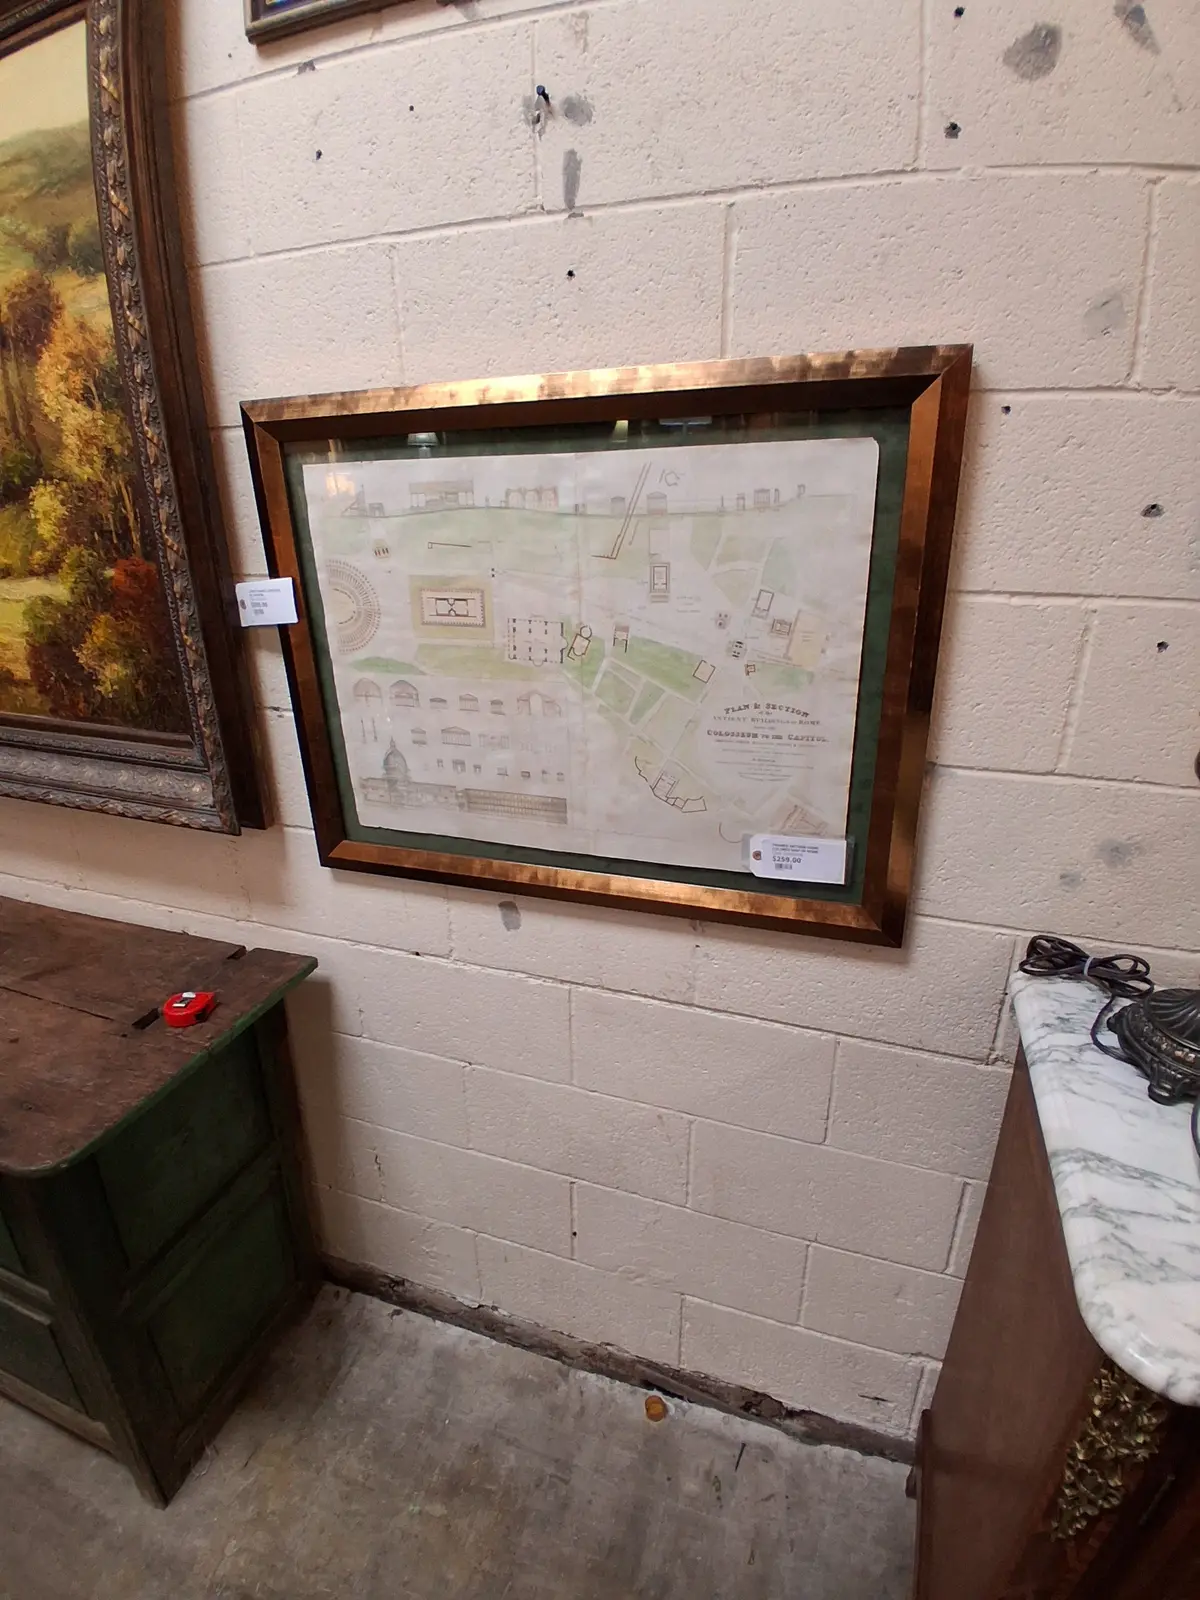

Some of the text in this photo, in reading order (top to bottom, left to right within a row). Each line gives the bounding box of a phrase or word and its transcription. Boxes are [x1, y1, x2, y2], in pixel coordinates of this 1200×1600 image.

[724, 702, 810, 718] PLAN & SECTION
[772, 855, 802, 864] $259.00
